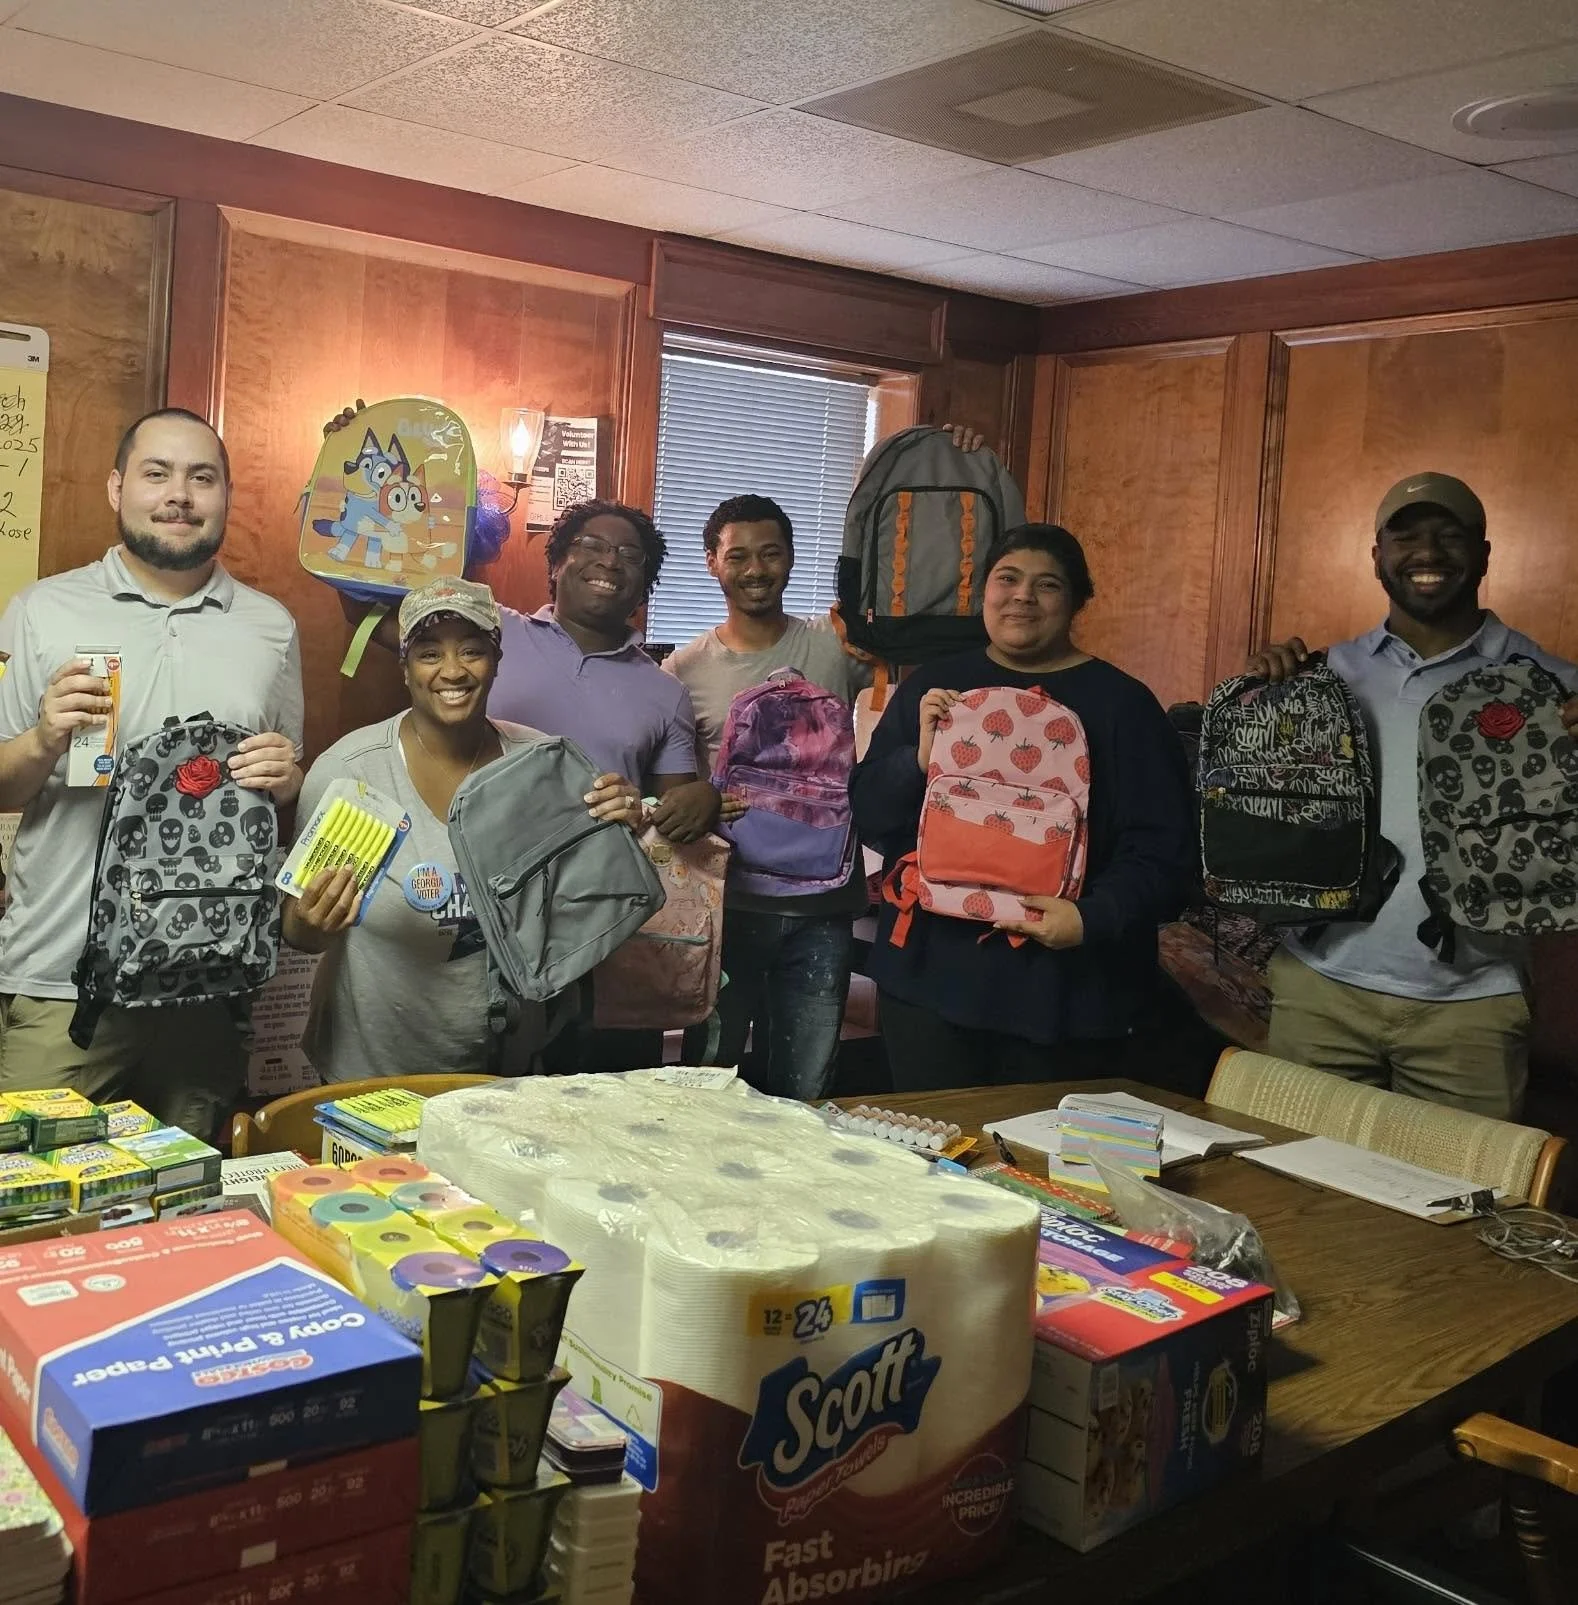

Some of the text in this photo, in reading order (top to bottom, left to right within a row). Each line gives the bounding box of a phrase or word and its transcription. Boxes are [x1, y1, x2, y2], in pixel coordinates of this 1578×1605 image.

[27, 355, 40, 363] 3M
[0, 437, 41, 453] 025
[561, 430, 595, 439] Volunteer
[562, 439, 578, 448] With
[73, 736, 89, 749] 24
[300, 811, 326, 847] Promarx
[280, 871, 293, 886] 8
[411, 876, 444, 890] GEORGIA
[432, 866, 437, 876] A
[416, 888, 441, 900] VOTER
[58, 1245, 88, 1258] 20
[104, 1236, 143, 1252] 500
[1185, 1264, 1249, 1289] 208
[288, 1312, 367, 1341] Copy
[763, 1309, 783, 1325] 12
[793, 1295, 834, 1339] 24
[173, 1336, 259, 1366] Print
[256, 1331, 286, 1347] &
[71, 1354, 174, 1388] Paper
[194, 1353, 315, 1389] Costco
[618, 1374, 654, 1403] Promise
[772, 1331, 917, 1475] Scott
[783, 1431, 889, 1519] Paper Towels
[941, 1477, 1015, 1510] INCREDIBLE
[958, 1498, 1000, 1521] PRICE!
[762, 1528, 836, 1575] Fast
[760, 1548, 931, 1605] Absorbing
